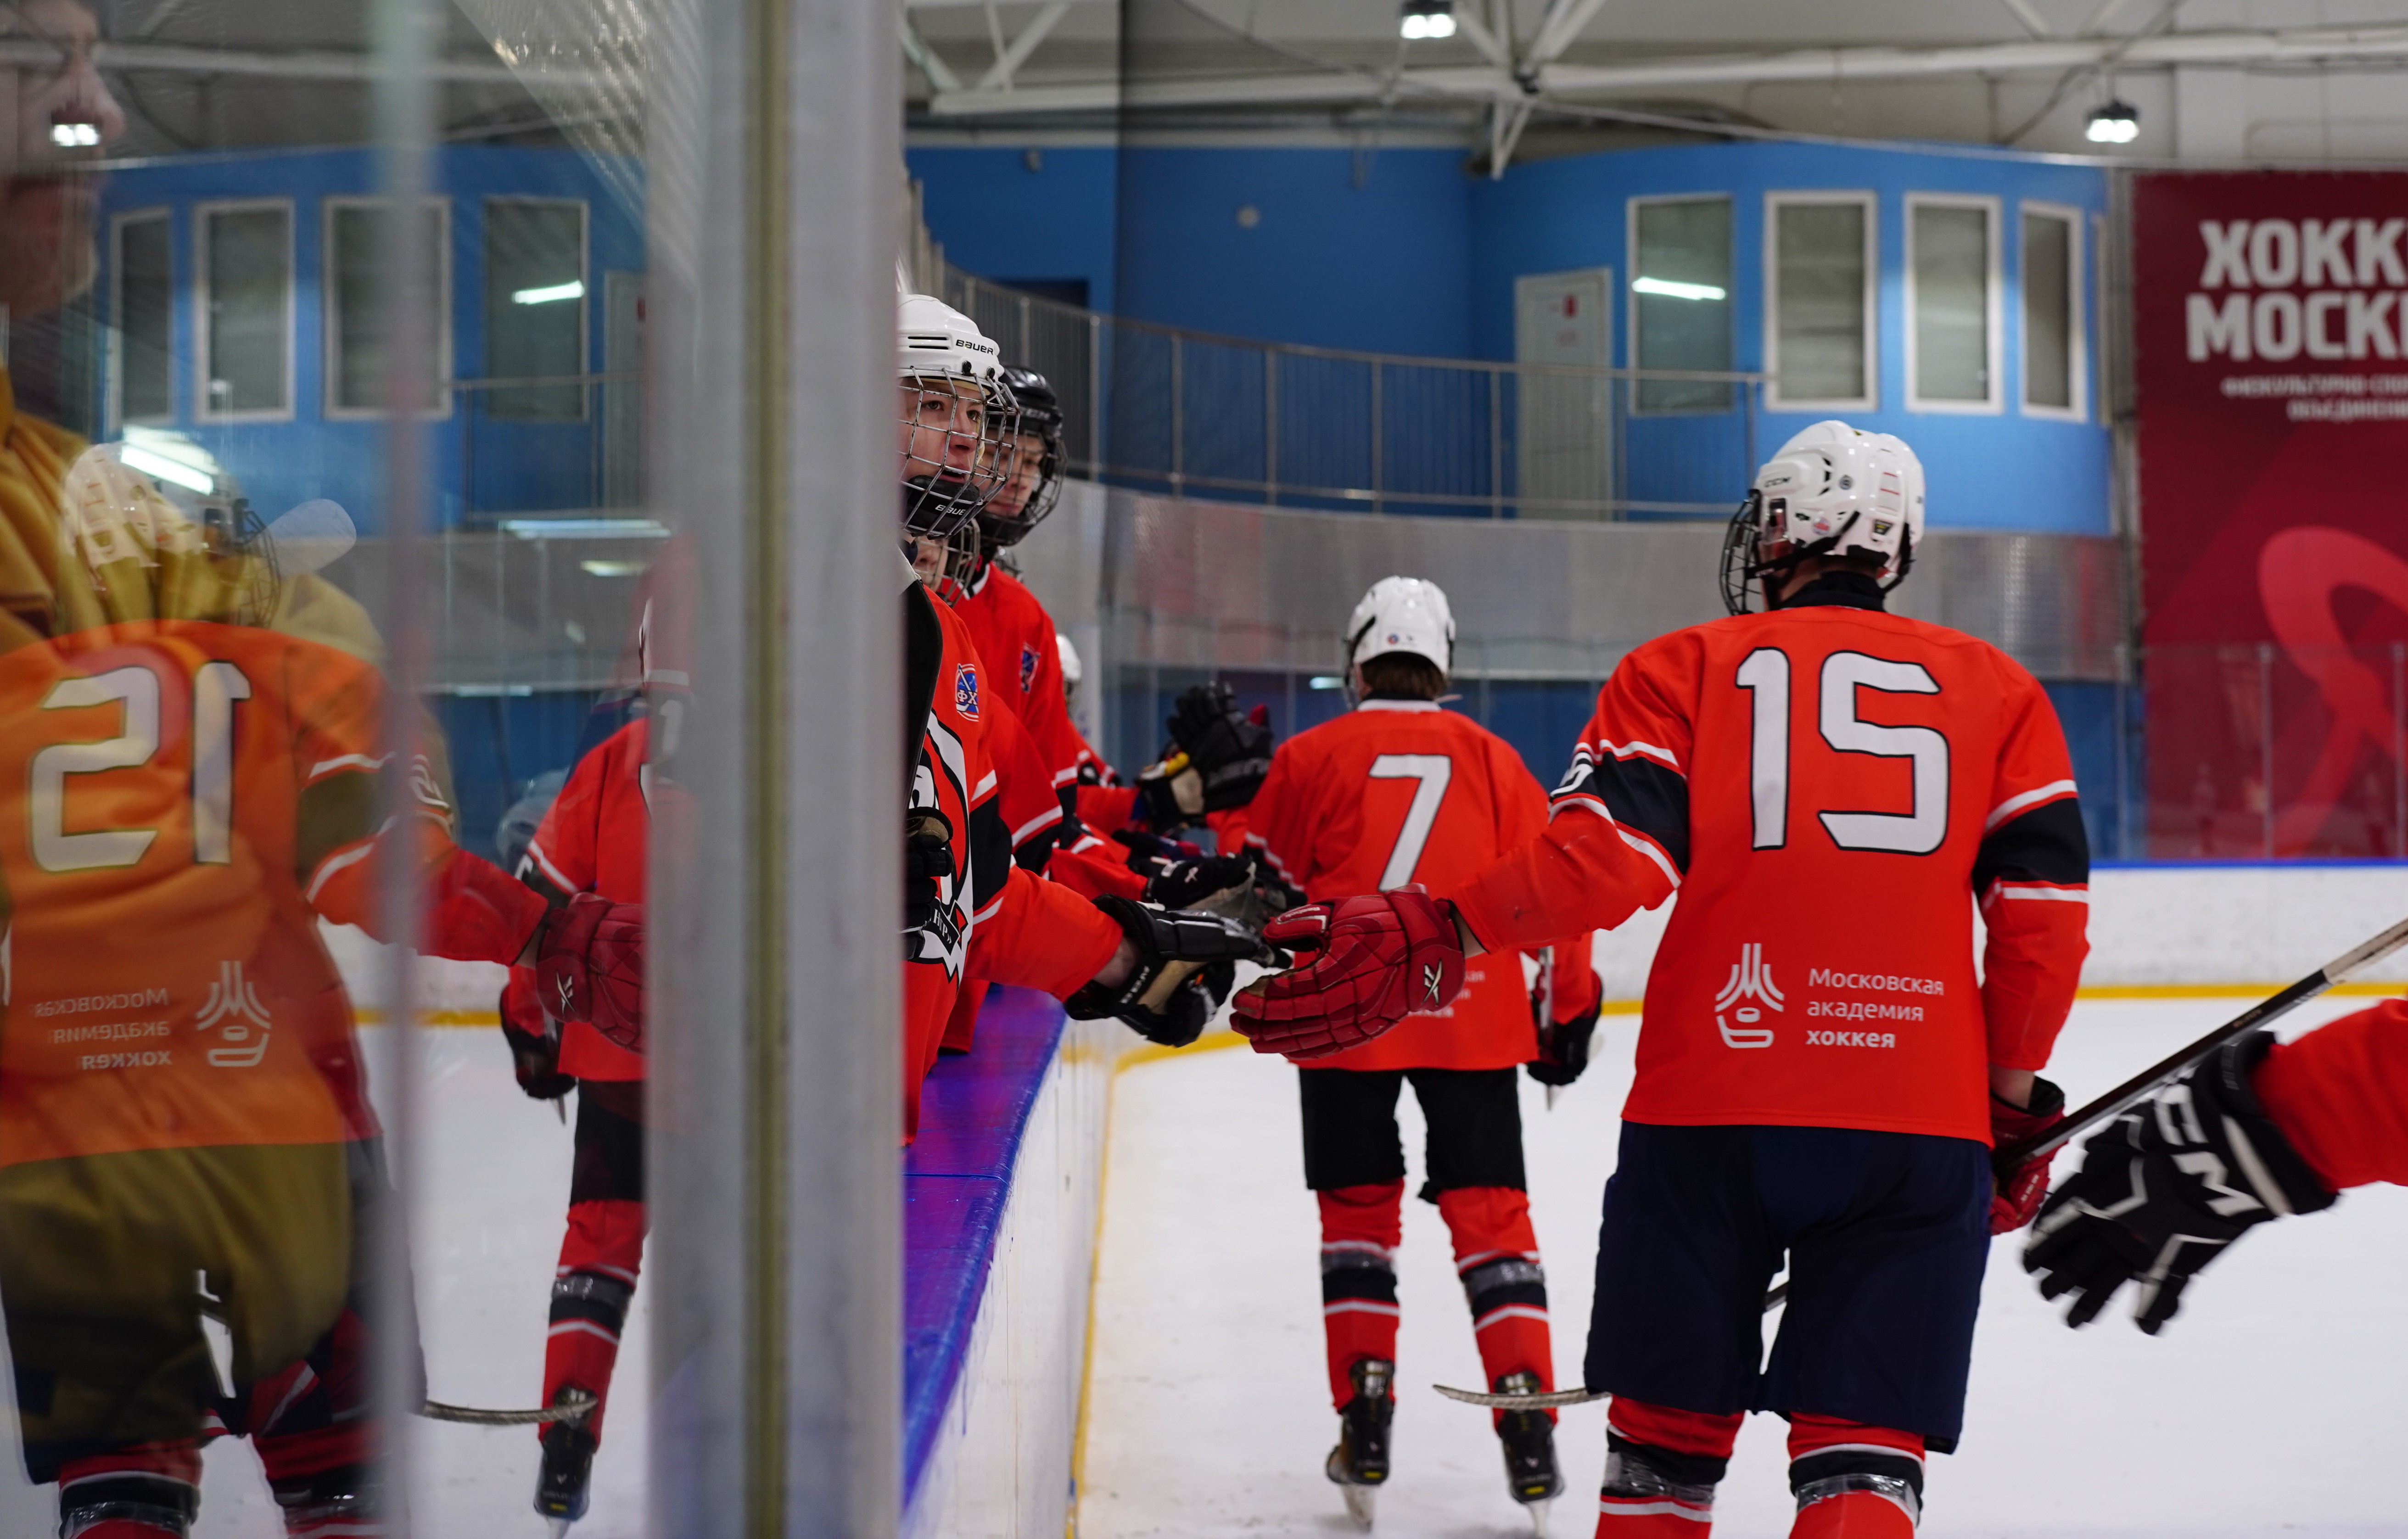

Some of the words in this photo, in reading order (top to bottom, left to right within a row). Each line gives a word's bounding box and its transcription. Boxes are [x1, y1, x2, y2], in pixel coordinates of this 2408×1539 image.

[2199, 217, 2408, 289] ХОКК
[2185, 290, 2408, 362] МОСК
[956, 339, 994, 355] BAUER
[935, 504, 966, 515] BAUE
[1736, 646, 1950, 856] 15
[1368, 753, 1452, 892] 7
[1808, 968, 1944, 996] Московская
[1807, 1001, 1924, 1022] академия
[1805, 1030, 1895, 1048] хоккея
